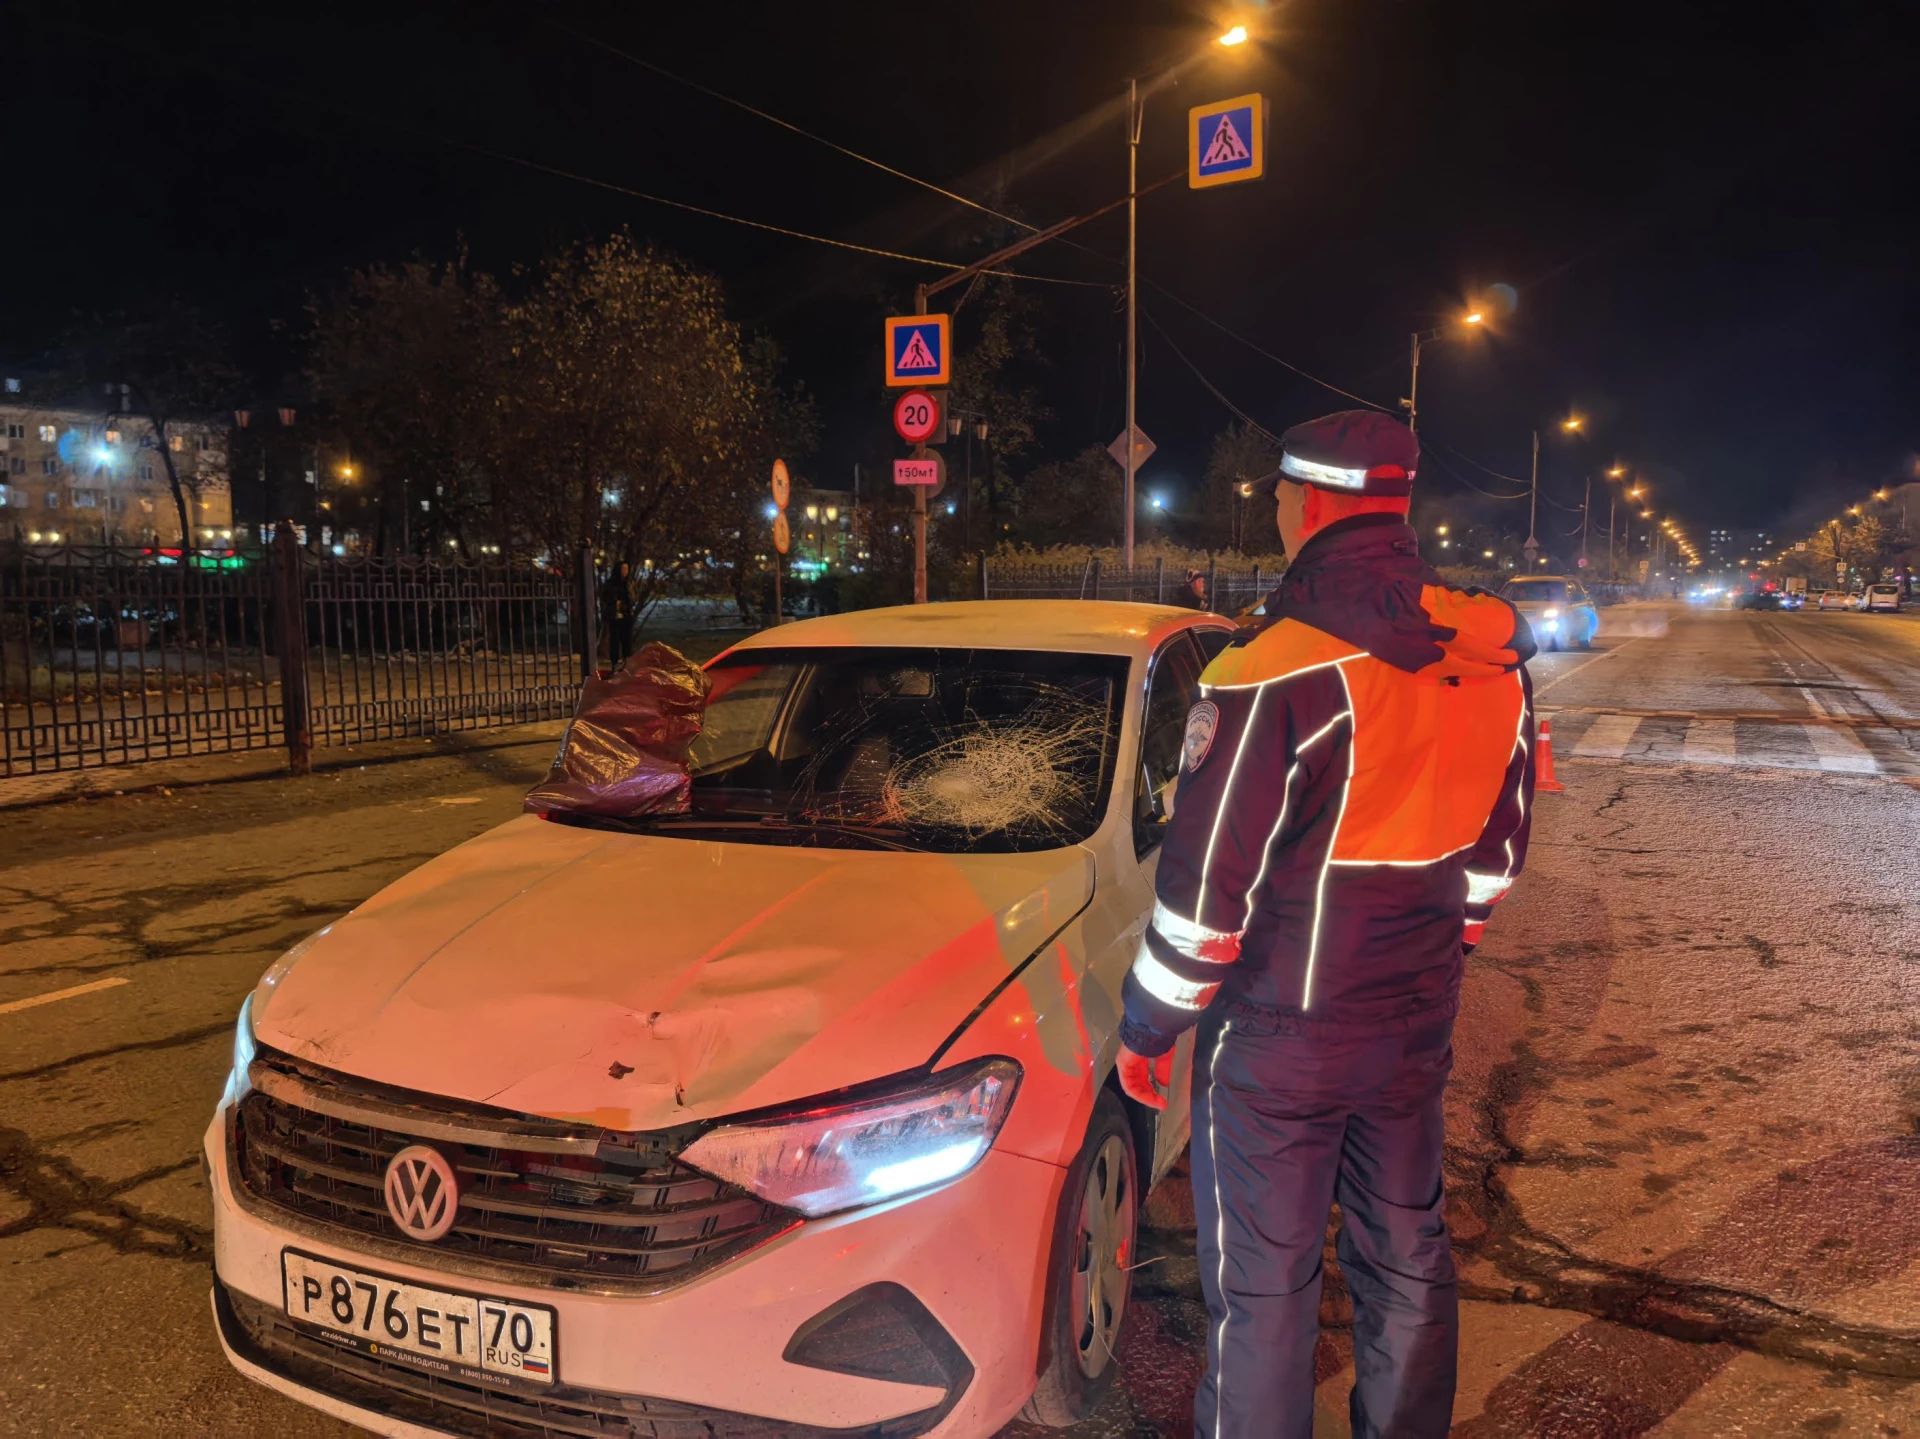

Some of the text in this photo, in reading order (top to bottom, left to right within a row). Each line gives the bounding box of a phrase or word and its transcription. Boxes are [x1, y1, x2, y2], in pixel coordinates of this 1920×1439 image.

[904, 405, 928, 426] 20
[904, 467, 927, 478] 50м
[485, 1306, 533, 1353] 70
[379, 1347, 449, 1372] ПАРК ДЛЯ ВОДИТЕЛЯ
[486, 1347, 521, 1368] RUS
